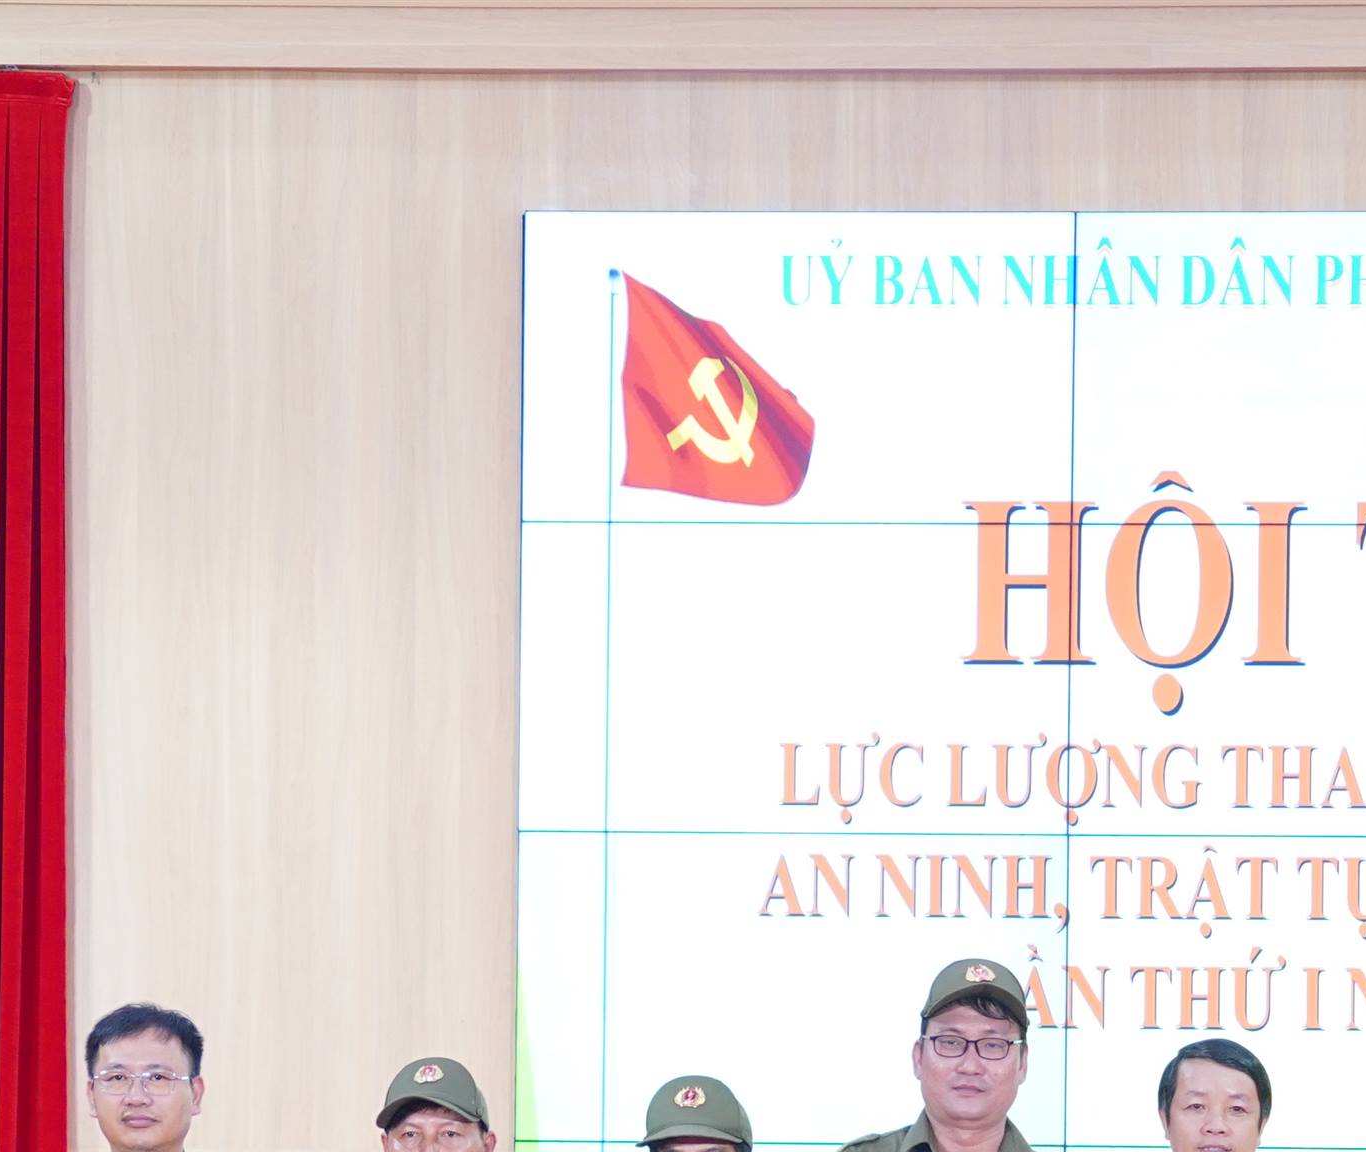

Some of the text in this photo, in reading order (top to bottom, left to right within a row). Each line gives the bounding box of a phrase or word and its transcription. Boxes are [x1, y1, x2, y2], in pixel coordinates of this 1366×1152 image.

[781, 238, 853, 306] UỶ
[874, 255, 981, 307] BAN
[1002, 237, 1160, 307] NHÂN
[1181, 237, 1296, 307] DÂN
[959, 470, 1308, 716] HỘI
[780, 732, 925, 824] LỰC
[947, 732, 1203, 826] LƯỢNG
[758, 853, 855, 918] AN
[875, 854, 1070, 934] NINH,
[1090, 845, 1279, 938] TRẬT
[1023, 944, 1110, 1030] ẦN
[1130, 946, 1287, 1031] THỨ
[1302, 968, 1324, 1031] I
